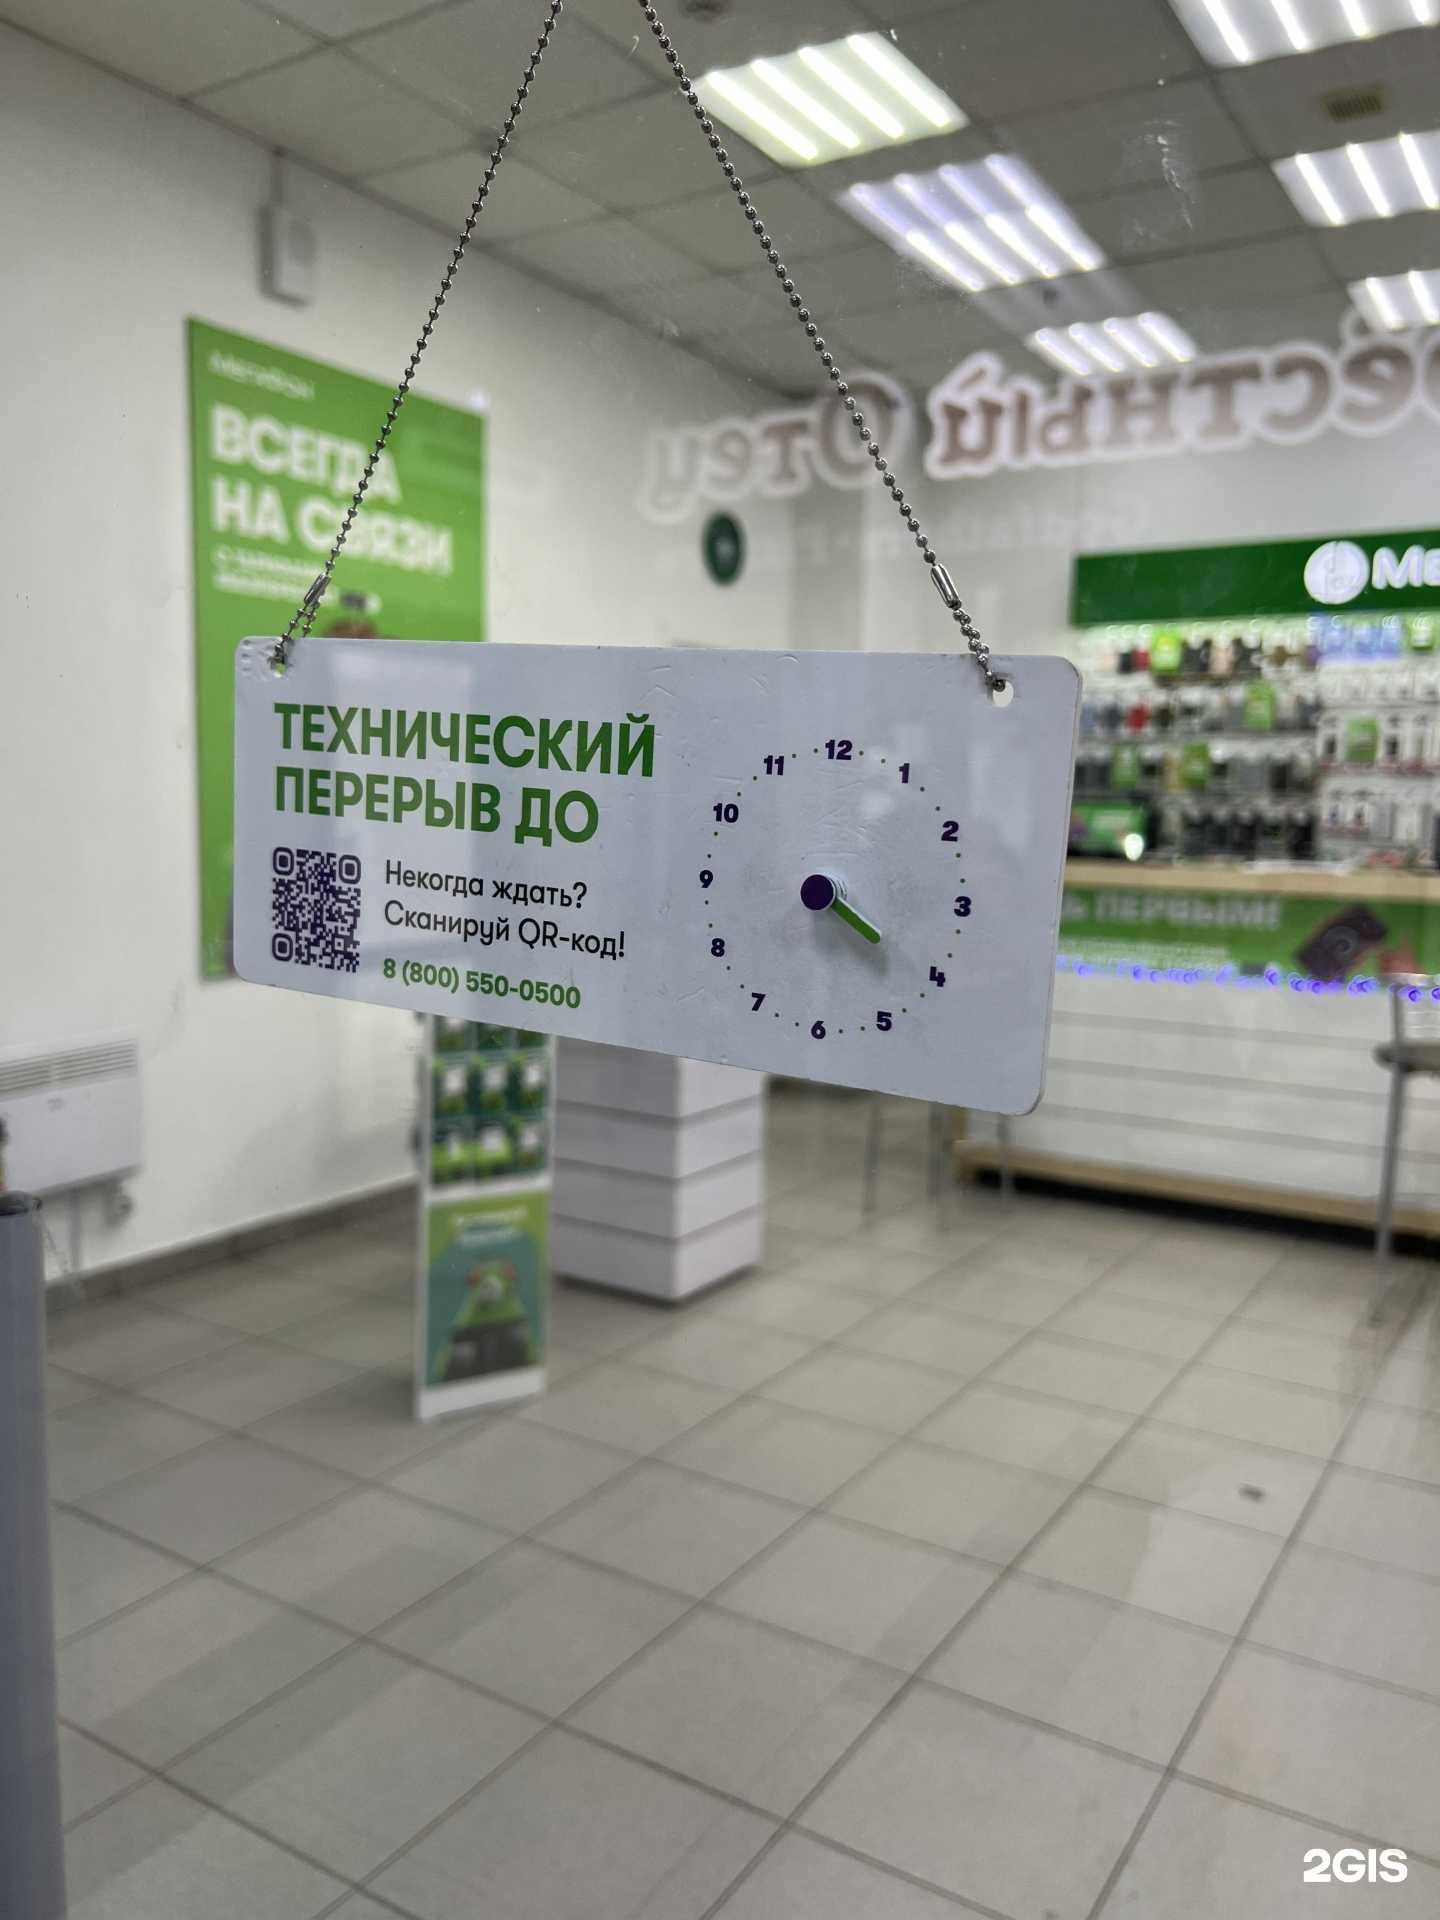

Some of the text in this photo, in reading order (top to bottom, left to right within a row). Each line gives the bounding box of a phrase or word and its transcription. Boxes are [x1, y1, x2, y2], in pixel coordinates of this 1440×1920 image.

[211, 402, 404, 506] ВСЕГДА
[211, 474, 289, 545] НА
[297, 494, 454, 578] СВЯЗИ
[274, 702, 655, 777] ТЕХНИЧЕСКИЙ
[825, 740, 853, 760] 12
[763, 755, 784, 776] 11
[899, 763, 910, 784] 1
[275, 766, 599, 847] ПЕРЕРЫВ ДО
[713, 803, 739, 823] 10
[941, 821, 959, 842] 2
[386, 860, 588, 909] Некогда ждать?
[699, 870, 714, 888] 9
[954, 896, 972, 917] 3
[384, 900, 625, 961] Сканируй QR-код!
[711, 938, 725, 957] 8
[383, 958, 581, 1009] 8 (800) 550-0500
[929, 966, 946, 987] 4
[751, 992, 766, 1011] 7
[811, 1021, 826, 1039] 6
[876, 1011, 892, 1031] 5
